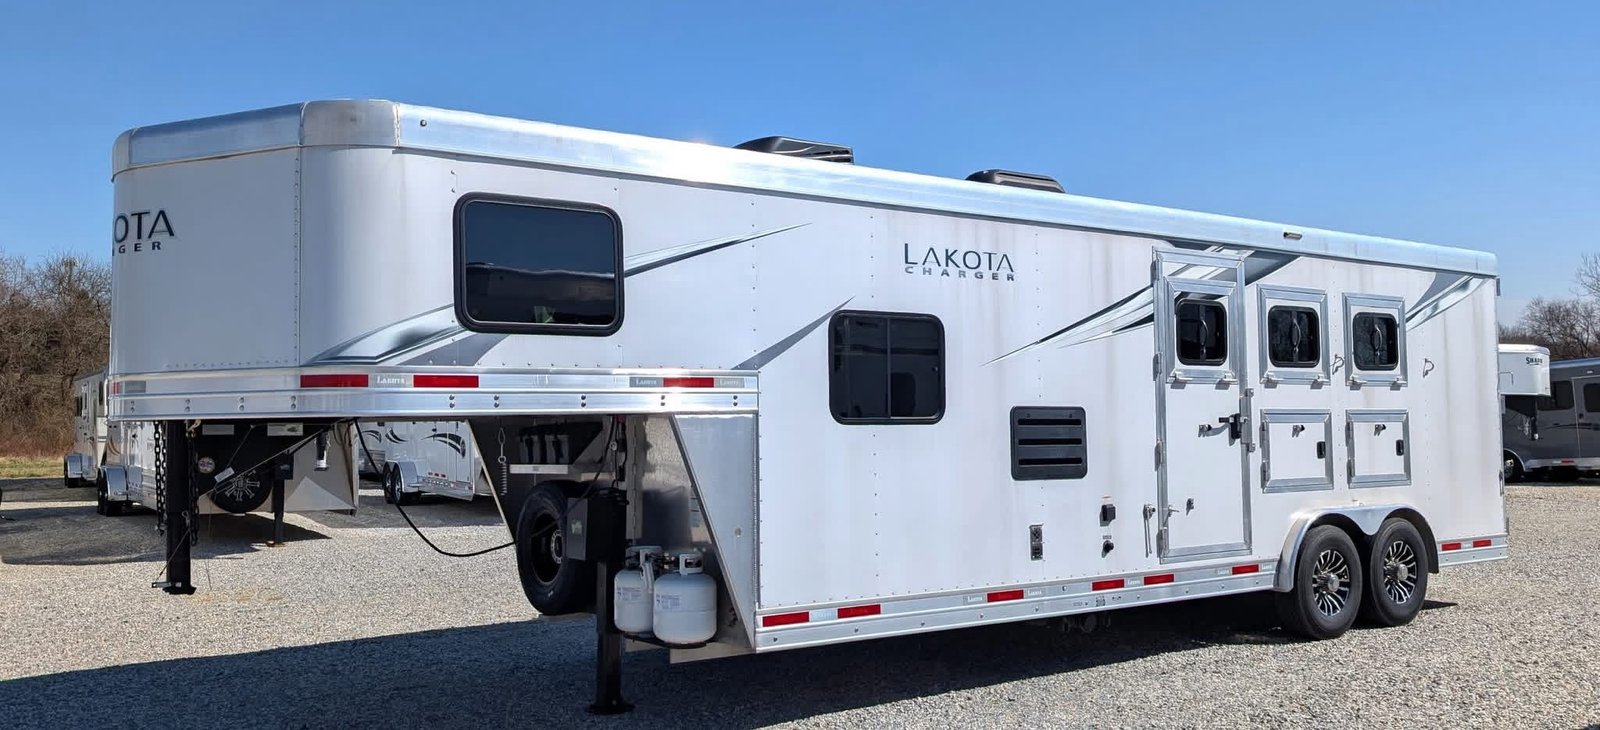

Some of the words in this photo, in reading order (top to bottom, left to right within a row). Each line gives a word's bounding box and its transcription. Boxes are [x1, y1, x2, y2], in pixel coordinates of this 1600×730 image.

[112, 241, 162, 255] GER
[904, 242, 1014, 273] LAKOTA
[904, 266, 1015, 282] CHARGER
